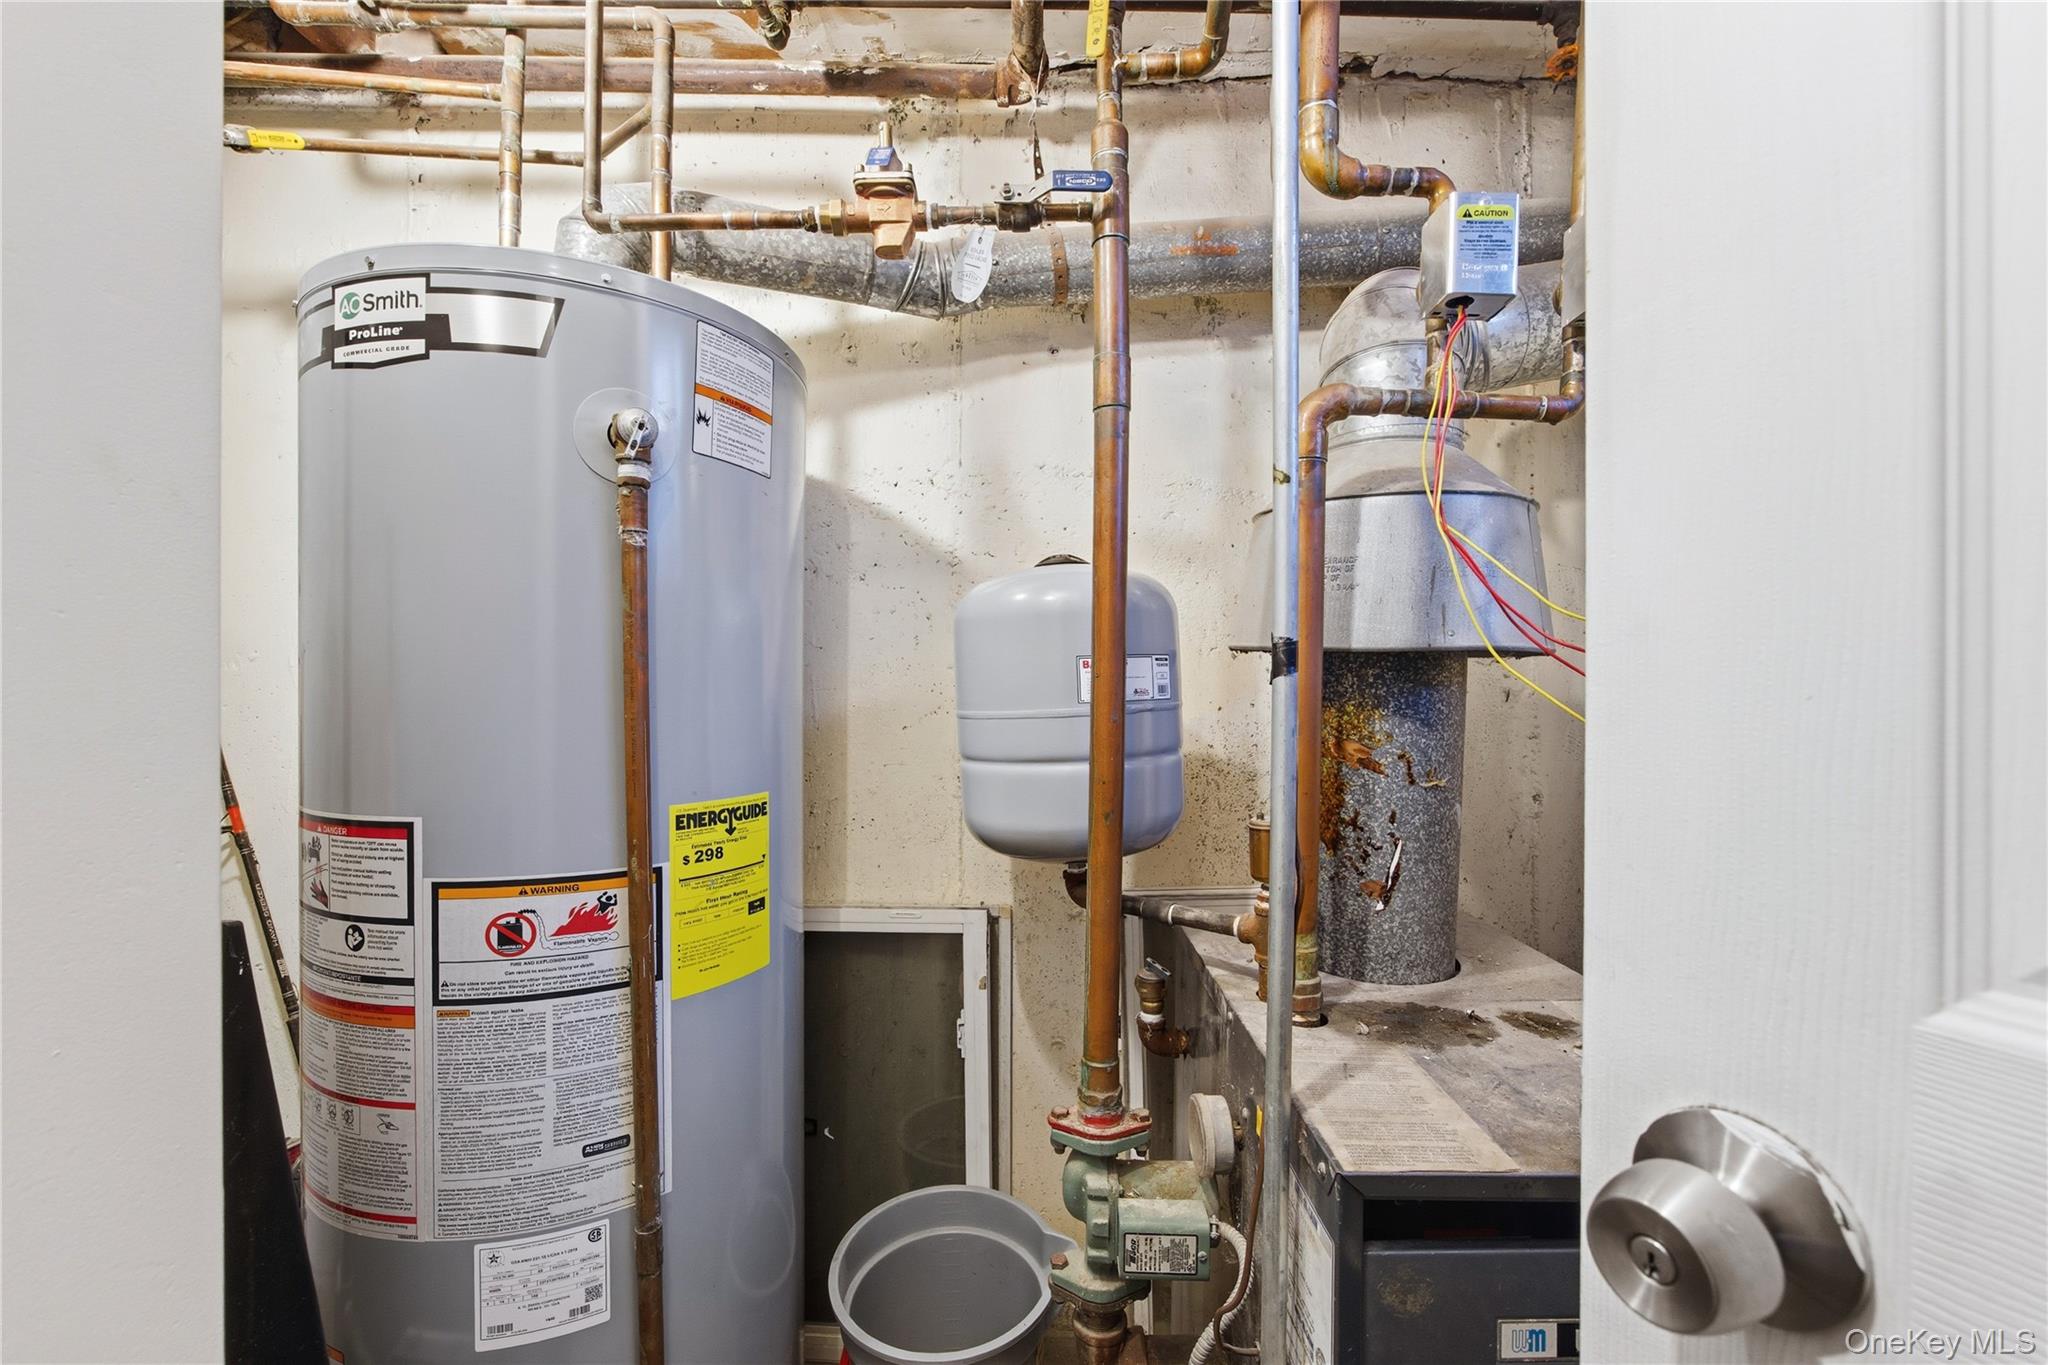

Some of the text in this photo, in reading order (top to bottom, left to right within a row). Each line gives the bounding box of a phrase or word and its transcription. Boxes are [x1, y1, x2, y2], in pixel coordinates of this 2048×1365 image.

[363, 290, 419, 312] Smith
[349, 326, 401, 340] ProLine
[343, 348, 383, 358] COMMERCIAL
[675, 801, 768, 833] ENERGYGUIDE
[682, 846, 724, 866] $ 298
[530, 884, 580, 894] WARNING
[536, 957, 566, 965] EXPLOSION
